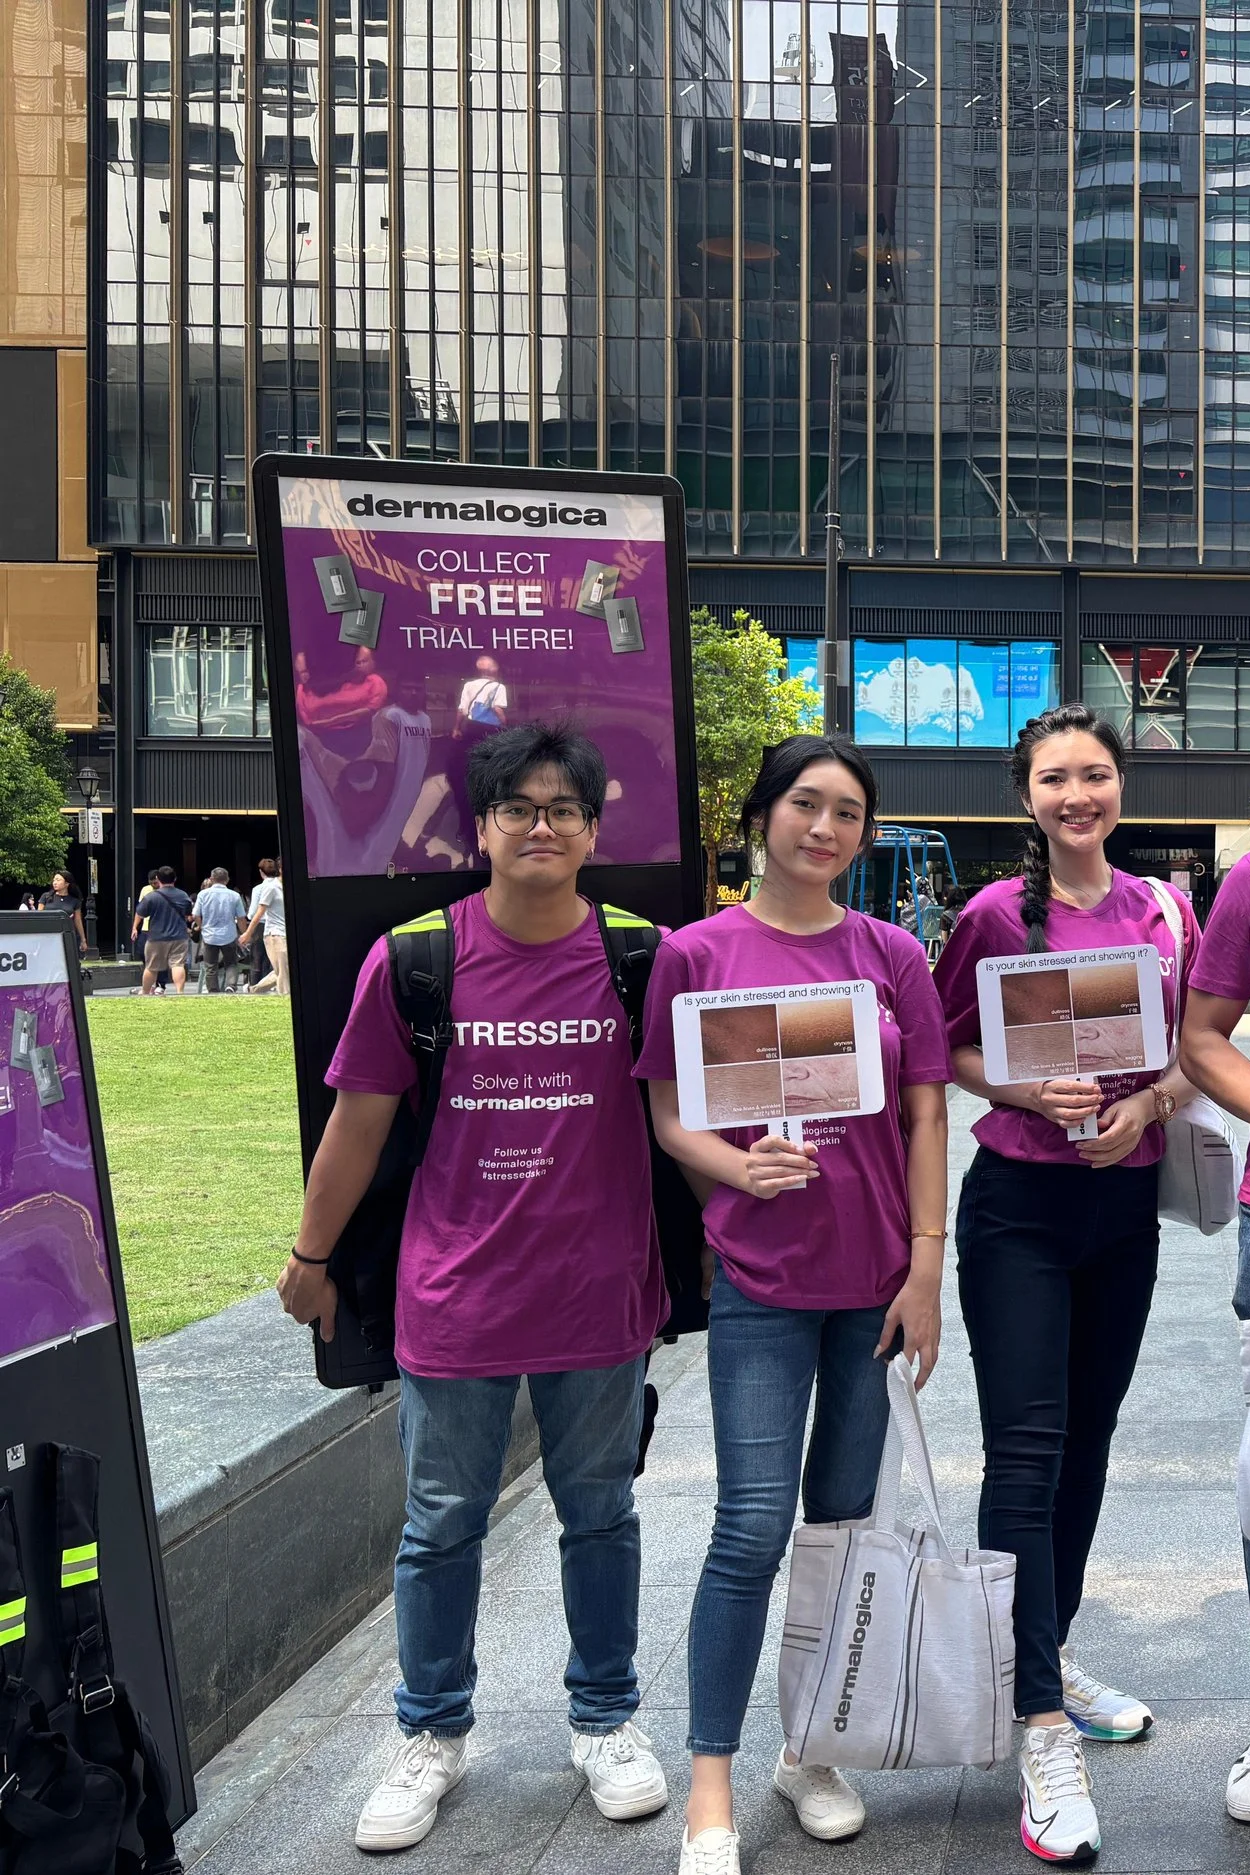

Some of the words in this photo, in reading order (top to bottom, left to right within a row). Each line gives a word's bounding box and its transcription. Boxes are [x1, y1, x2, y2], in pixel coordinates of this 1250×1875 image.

[347, 494, 607, 527] dermalogica
[416, 549, 550, 574] COLLECT
[430, 583, 544, 616] FREE
[400, 626, 484, 649] TRIAL
[492, 628, 573, 650] HERE!
[985, 963, 994, 971] Is
[996, 961, 1016, 973] your
[1018, 958, 1036, 968] skin
[1039, 955, 1077, 966] stressed
[1079, 953, 1096, 963] and
[1099, 950, 1136, 965] showing
[1137, 948, 1148, 958] it?
[684, 997, 693, 1006] Is
[695, 996, 717, 1010] your
[720, 992, 741, 1003] skin
[743, 989, 786, 1001] stressed
[788, 987, 807, 998] and
[810, 984, 851, 999] showing
[853, 983, 864, 993] it?
[453, 1018, 617, 1046] TRESSED?
[472, 1074, 519, 1090] Solve
[523, 1073, 532, 1089] it
[539, 1072, 571, 1088] with
[450, 1093, 594, 1111] dermalogica
[494, 1148, 528, 1157] Follow
[531, 1147, 542, 1155] us
[833, 1571, 876, 1733] dermalogica
